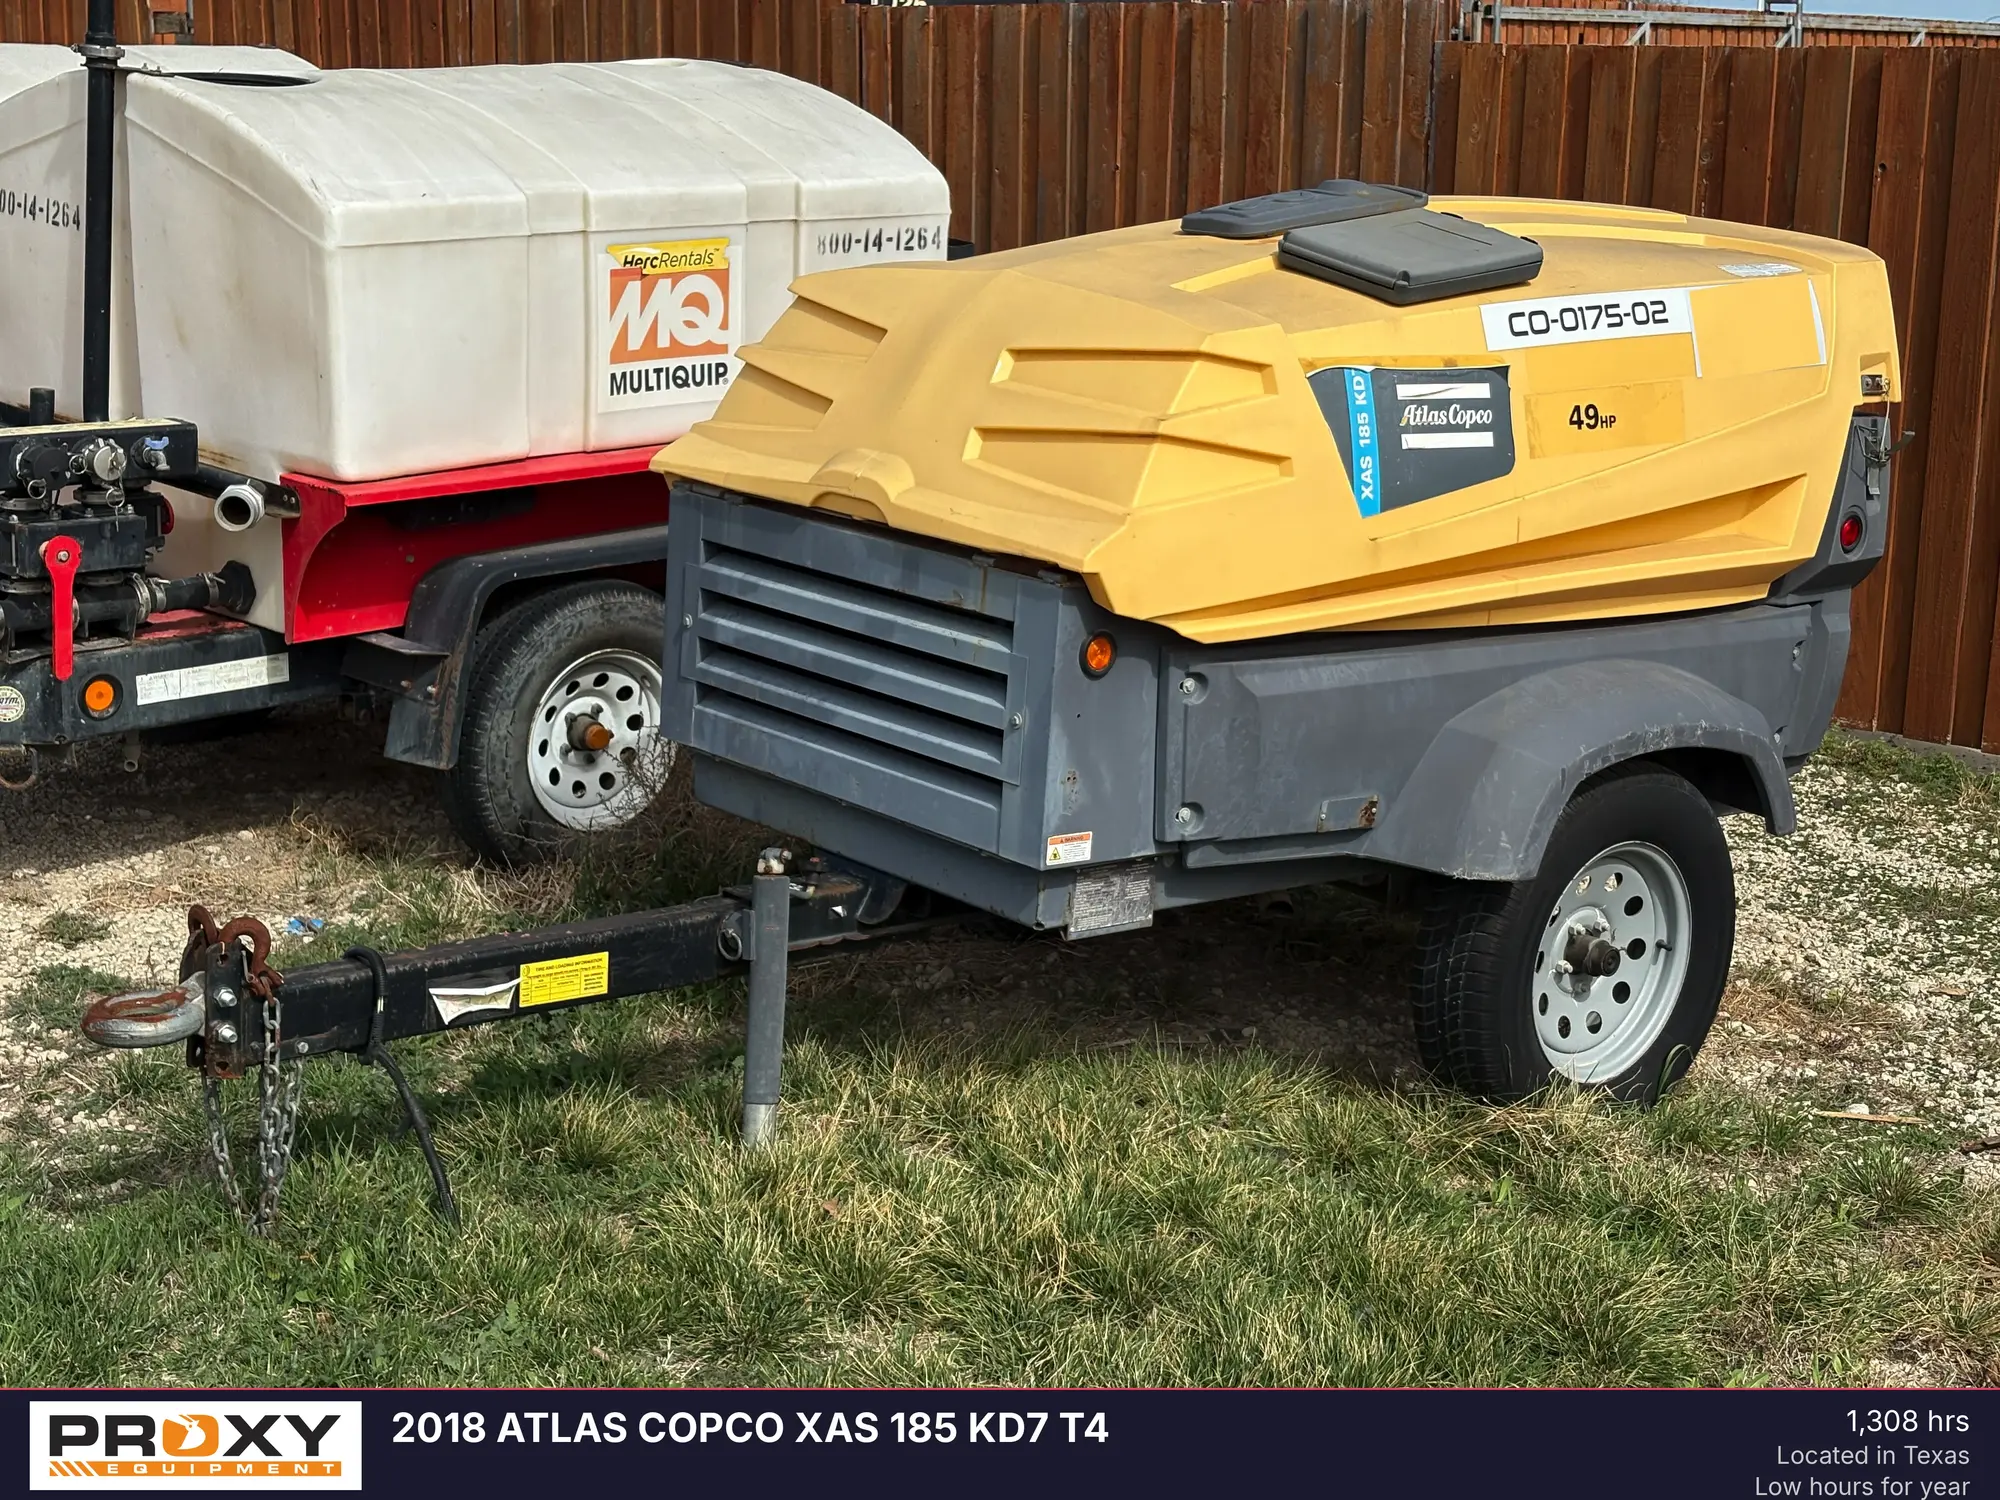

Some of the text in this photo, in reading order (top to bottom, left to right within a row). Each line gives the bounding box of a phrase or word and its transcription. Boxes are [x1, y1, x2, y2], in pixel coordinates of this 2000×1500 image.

[0, 188, 81, 231] 00-14-1264
[817, 225, 941, 256] 800-14-1264
[610, 274, 729, 351] MQ
[1508, 300, 1669, 337] CO-0175-02
[1352, 369, 1374, 500] XAS 185 KD
[1399, 403, 1493, 429] Atlas Copco
